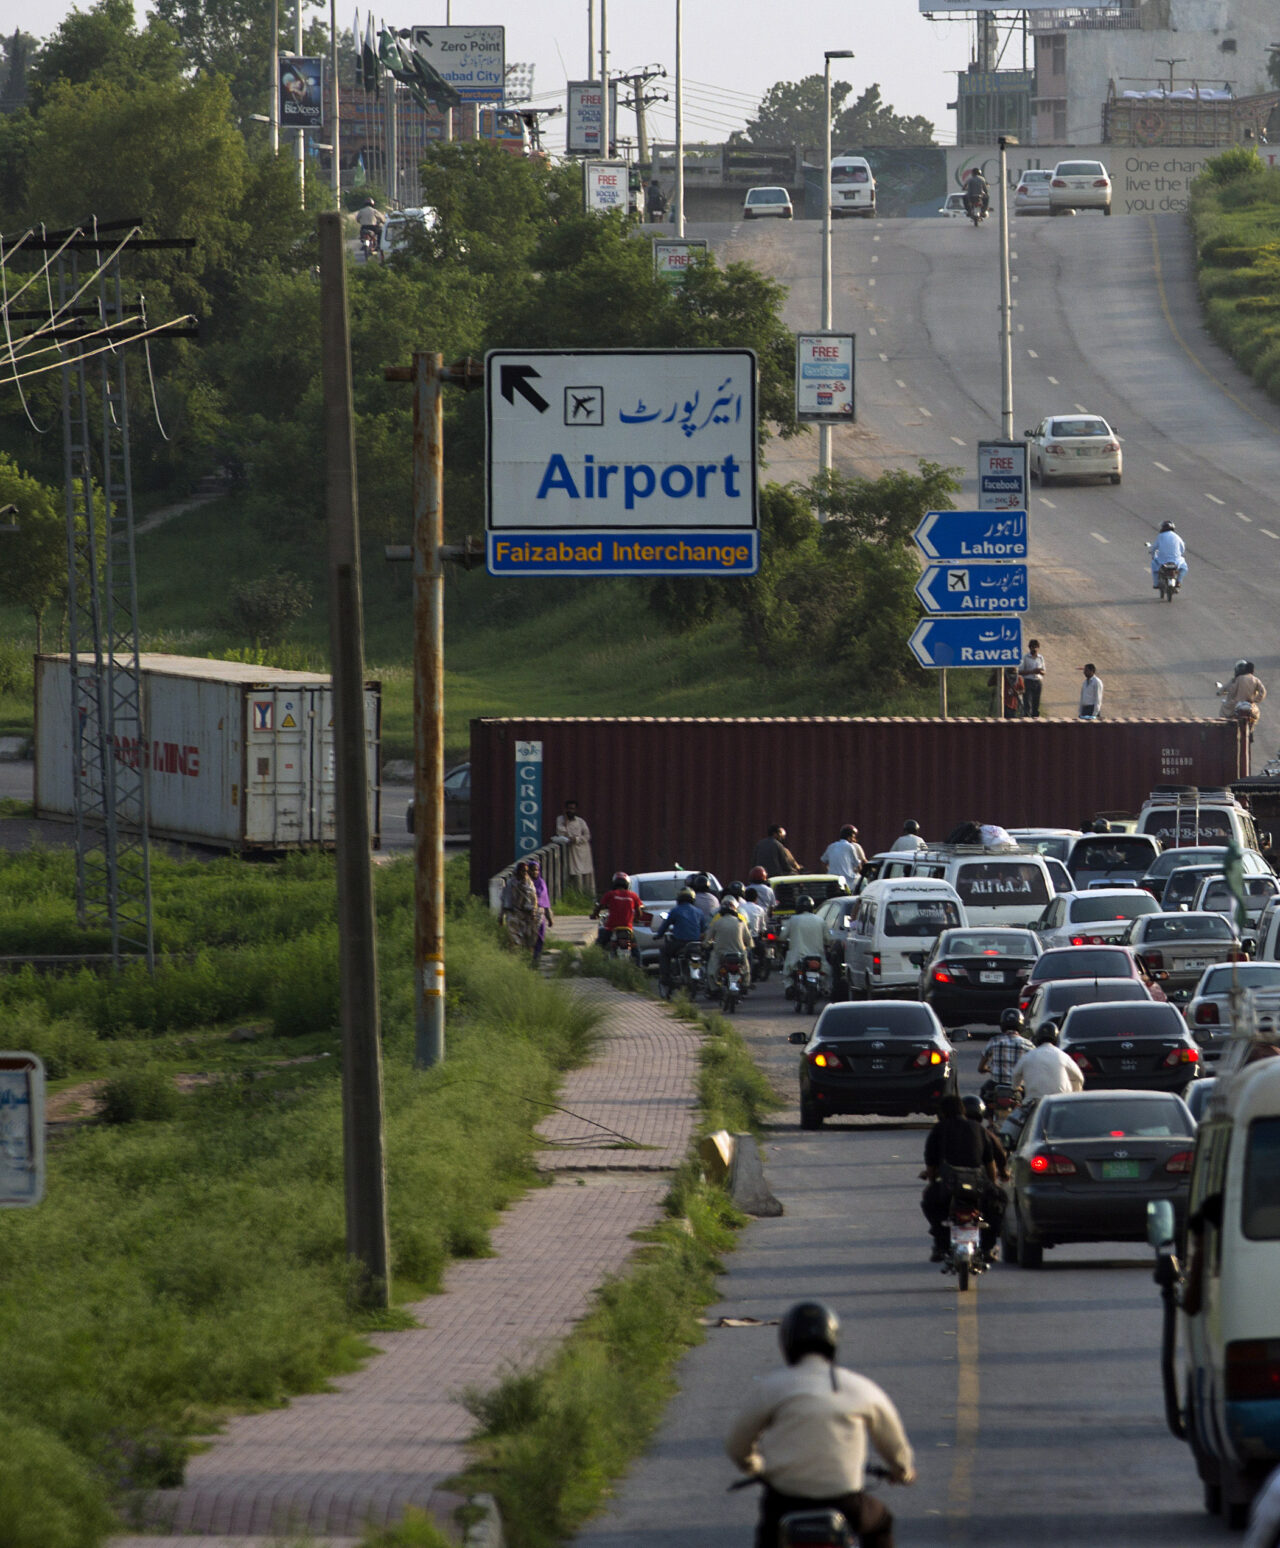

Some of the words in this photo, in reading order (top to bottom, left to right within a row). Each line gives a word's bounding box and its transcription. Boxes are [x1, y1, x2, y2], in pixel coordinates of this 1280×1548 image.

[441, 42, 467, 51] Zero
[470, 41, 500, 51] Point
[476, 70, 500, 82] City
[1126, 157, 1159, 172] One
[1163, 158, 1207, 172] chan
[598, 175, 617, 184] FREE
[1126, 176, 1150, 191] live
[1155, 176, 1182, 191] the
[1125, 199, 1154, 214] you
[1160, 195, 1190, 211] desi
[812, 346, 839, 357] FREE
[804, 366, 846, 377] twitter
[990, 458, 1013, 469] FREE
[536, 452, 741, 510] Airport
[984, 478, 1019, 490] facebook
[984, 516, 1023, 537] لاہور
[496, 542, 602, 562] Faizabad
[613, 542, 749, 566] Interchange
[961, 542, 1024, 554] Lahore
[961, 595, 1025, 610] Airport
[979, 625, 1017, 642] روات
[961, 648, 1019, 661] Rawat
[106, 734, 150, 768] ANG
[153, 741, 200, 777] MING
[971, 881, 993, 893] ALI
